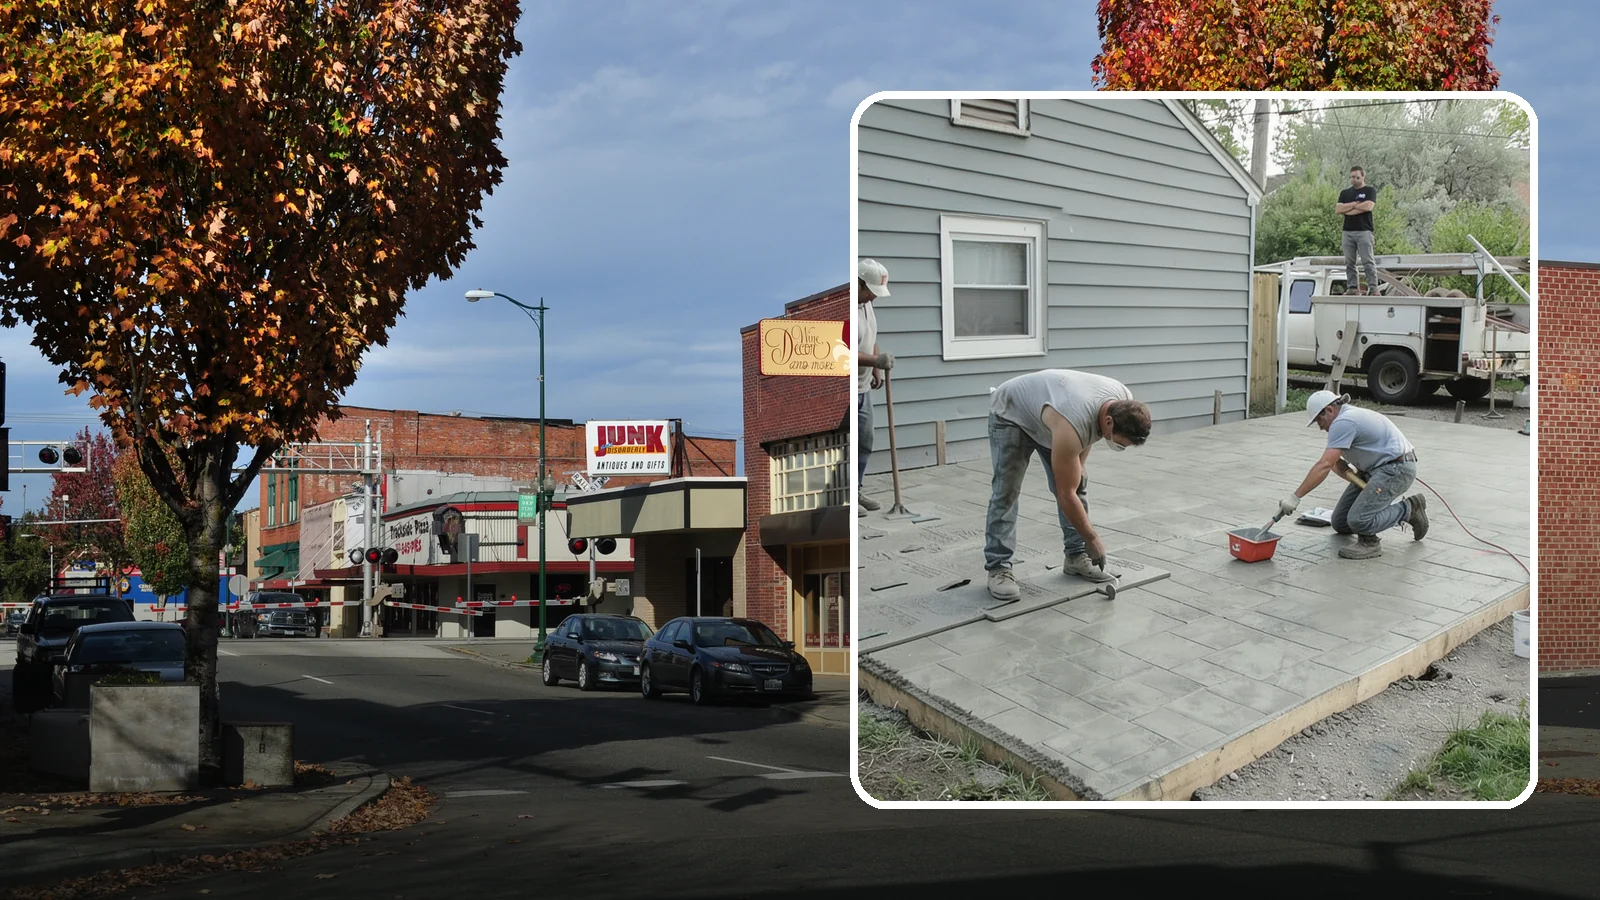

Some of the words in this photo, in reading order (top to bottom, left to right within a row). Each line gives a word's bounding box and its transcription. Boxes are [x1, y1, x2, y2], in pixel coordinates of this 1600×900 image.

[765, 328, 831, 365] Decor
[596, 425, 666, 457] JUNK
[607, 446, 646, 454] DISORDERLY
[597, 461, 628, 470] ANTIQUES
[631, 461, 644, 470] AND
[647, 460, 665, 470] GIFTS
[352, 498, 365, 511] CRO
[414, 519, 429, 535] Pizza
